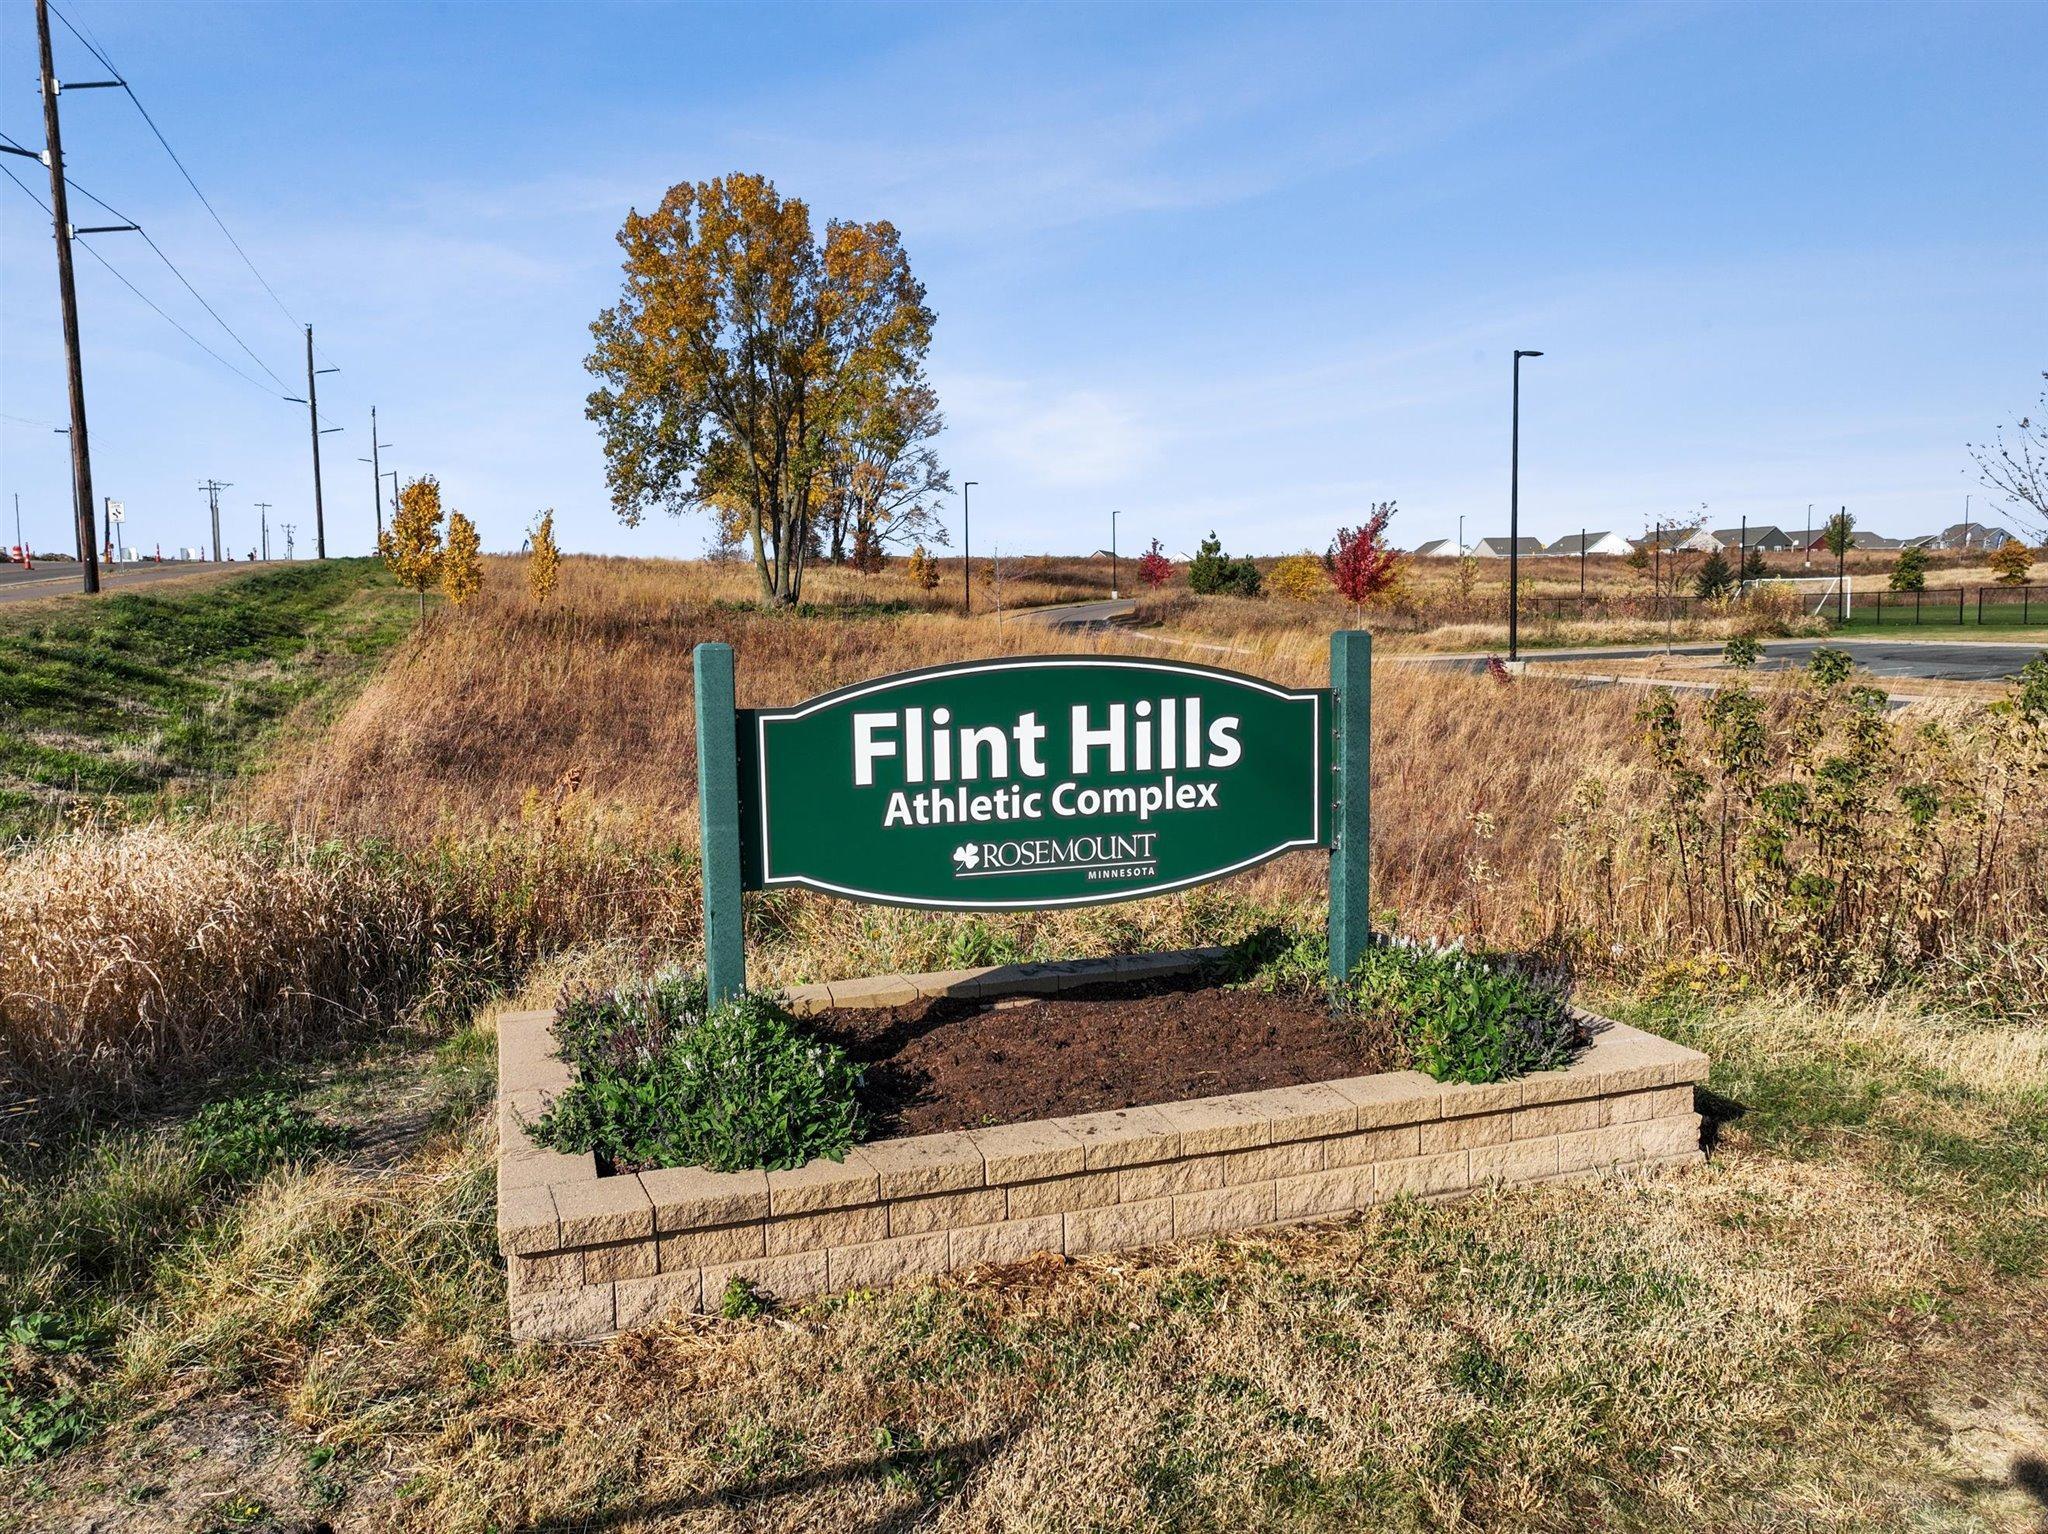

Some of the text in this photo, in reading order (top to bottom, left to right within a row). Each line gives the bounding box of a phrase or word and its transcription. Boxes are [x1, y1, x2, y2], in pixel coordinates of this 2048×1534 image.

[853, 697, 1242, 785] Flint Hills
[884, 775, 1218, 827] Athletic Complex
[982, 832, 1157, 868] ROSEMOUNT
[1088, 866, 1156, 880] MINNESOTA
